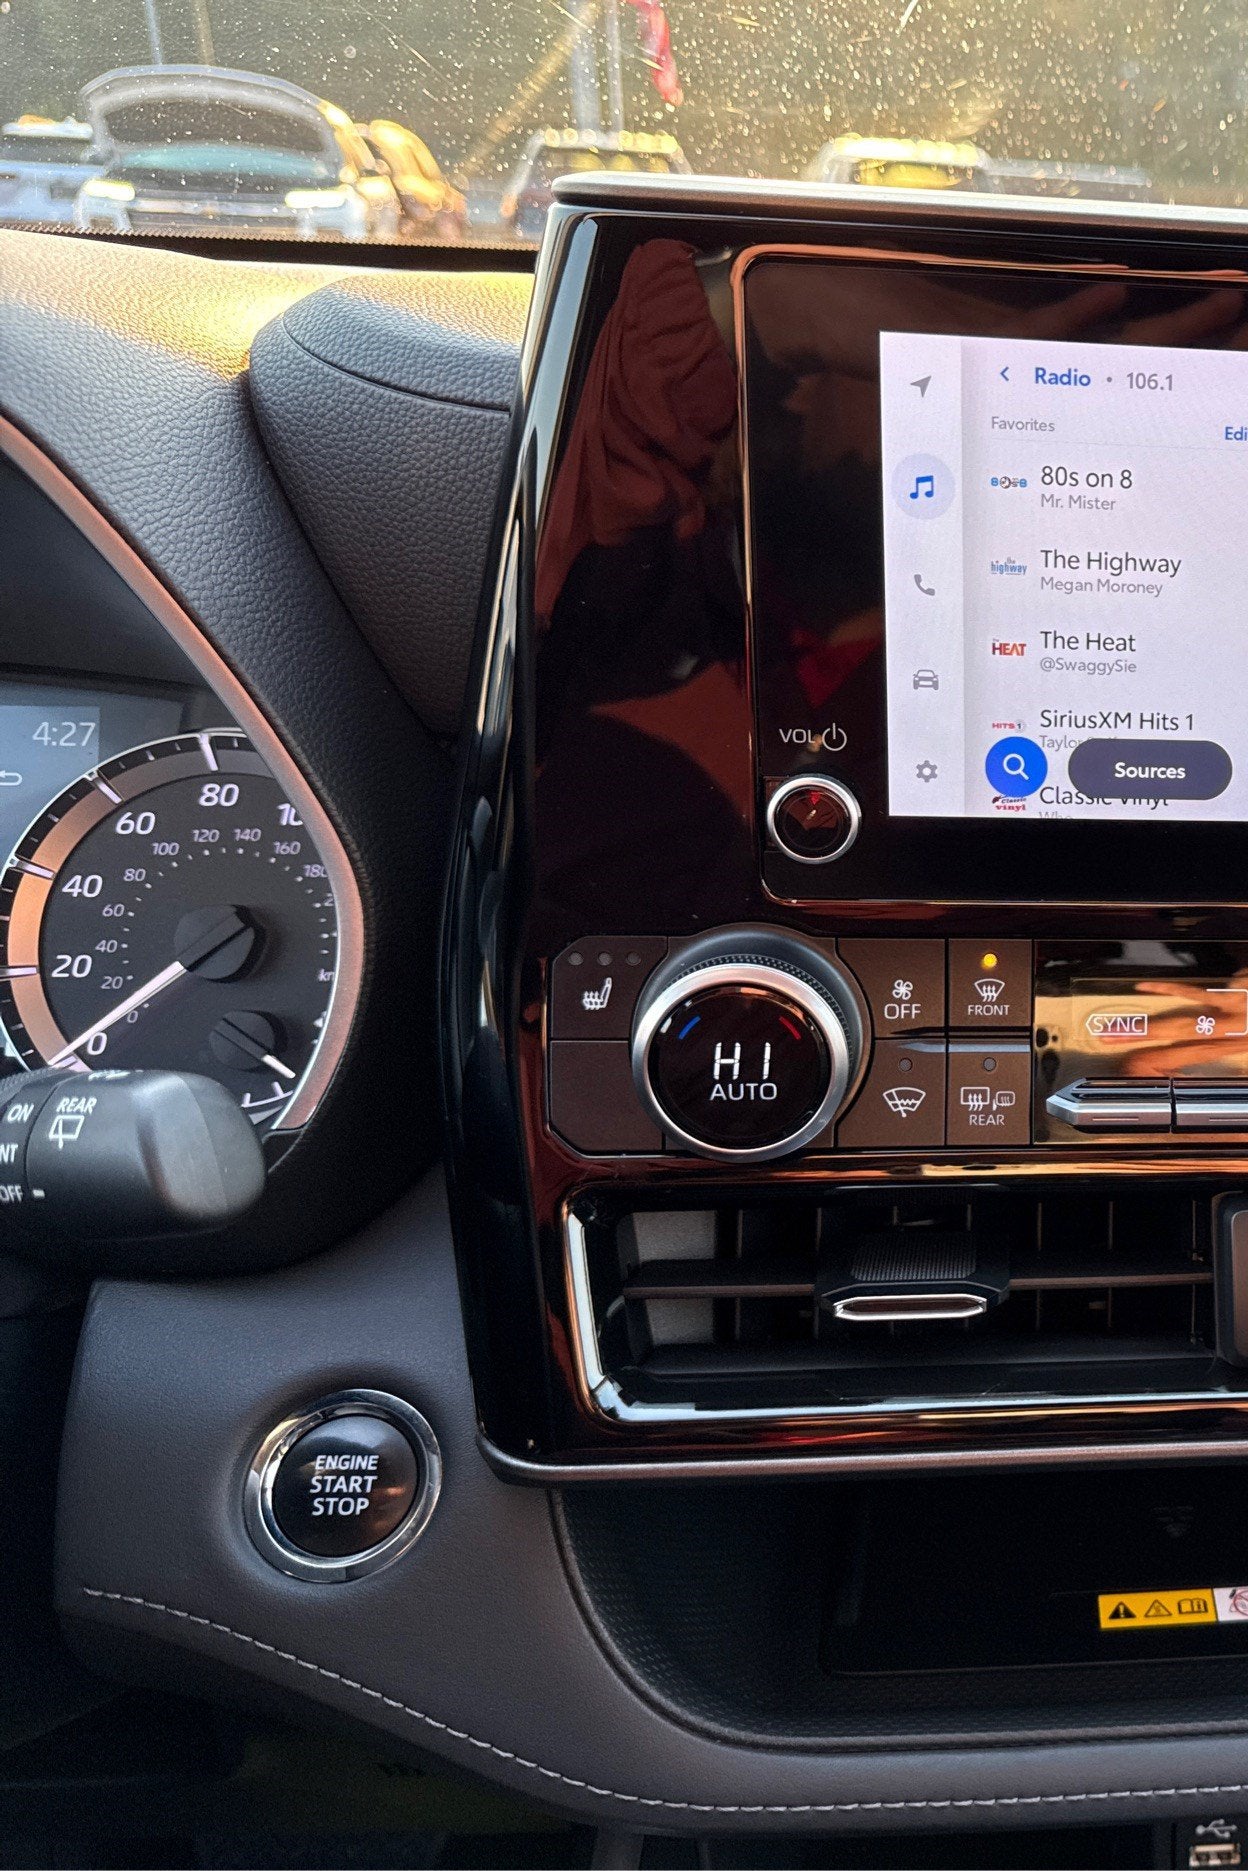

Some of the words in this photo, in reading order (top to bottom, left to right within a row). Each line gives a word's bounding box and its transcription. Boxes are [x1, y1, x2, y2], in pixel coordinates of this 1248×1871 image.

[1034, 366, 1091, 387] Radio
[1126, 372, 1174, 391] 106.1
[991, 416, 1056, 433] Favorites
[1041, 466, 1079, 487] 80s
[1086, 472, 1113, 488] on
[1120, 469, 1133, 489] 8
[1040, 495, 1064, 509] Mr.
[1068, 495, 1116, 511] Mister
[991, 561, 1027, 575] highway
[1040, 549, 1080, 570] The
[1086, 552, 1182, 577] Highway
[1040, 577, 1094, 594] Megan
[1097, 578, 1163, 595] Moroney
[992, 643, 1026, 656] HEAT
[1040, 631, 1079, 651] The
[1085, 632, 1136, 652] Heat
[1040, 657, 1137, 675] @SwaggySie
[992, 722, 1015, 730] HITS
[1040, 709, 1132, 730] SiriusXM
[1139, 712, 1178, 731] Hits
[1186, 714, 1194, 731] 1
[32, 722, 96, 747] 4:27
[779, 728, 814, 744] VOL
[1040, 735, 1081, 752] Taylo
[1115, 761, 1186, 779] Sources
[199, 783, 239, 807] 80
[115, 812, 156, 835] 60
[193, 829, 219, 843] 120
[234, 829, 261, 843] 140
[152, 843, 179, 856] 100
[273, 842, 301, 855] 160
[124, 869, 146, 882] 80
[62, 874, 103, 898] 40
[102, 904, 124, 917] 60
[95, 940, 117, 953] 40
[51, 954, 92, 978] 20
[101, 976, 123, 990] 20
[127, 1010, 138, 1023] 0
[884, 1003, 921, 1020] OFF
[967, 1004, 1010, 1017] FRONT
[1093, 1016, 1144, 1034] SYNC
[87, 1032, 107, 1056] 0
[713, 1042, 771, 1080] HI
[710, 1083, 777, 1101] AUTO
[7, 1103, 34, 1123] ON
[56, 1096, 97, 1114] REAR
[969, 1114, 1006, 1126] REAR
[0, 1143, 18, 1163] NT
[0, 1184, 23, 1202] OFF
[315, 1454, 380, 1471] ENGINE
[309, 1475, 378, 1494] START
[311, 1497, 370, 1516] STOP
